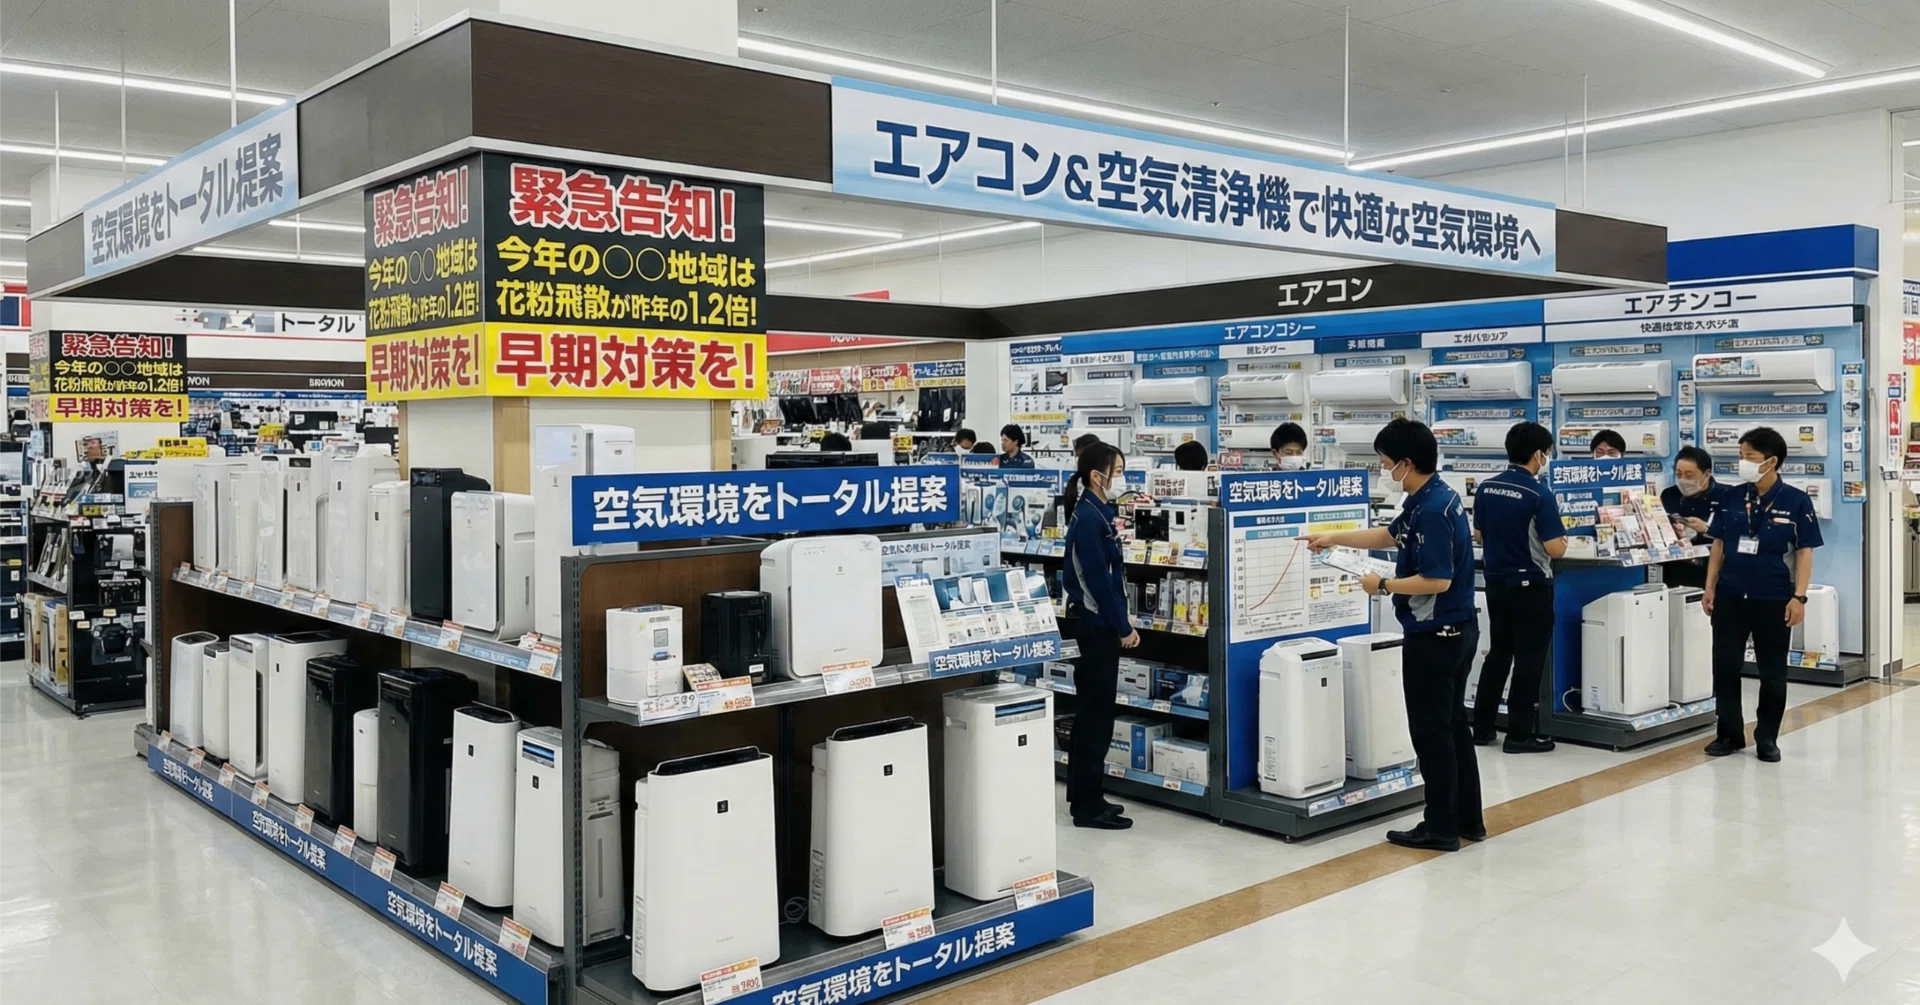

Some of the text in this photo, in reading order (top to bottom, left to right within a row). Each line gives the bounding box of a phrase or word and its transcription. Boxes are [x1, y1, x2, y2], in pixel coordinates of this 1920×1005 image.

[92, 132, 284, 264] 空気環境をトータル提案
[373, 165, 469, 249] 緊急告知!
[510, 162, 736, 243] 緊急告知!
[873, 118, 1542, 264] エアコン&空気清浄機で快適な空気環境へ
[1277, 277, 1374, 308] エアコン
[62, 332, 174, 359] 緊急告知!
[1224, 321, 1317, 340] エアコンコシー
[370, 333, 480, 393] 早期対策を!
[495, 331, 756, 391] 早期対策を!
[55, 397, 183, 419] 早期対策を!
[593, 474, 948, 532] 空気環境をトータル提案
[933, 640, 1056, 672] 空気環境をトータル提案
[387, 891, 498, 978] 空気環境をトータル提案
